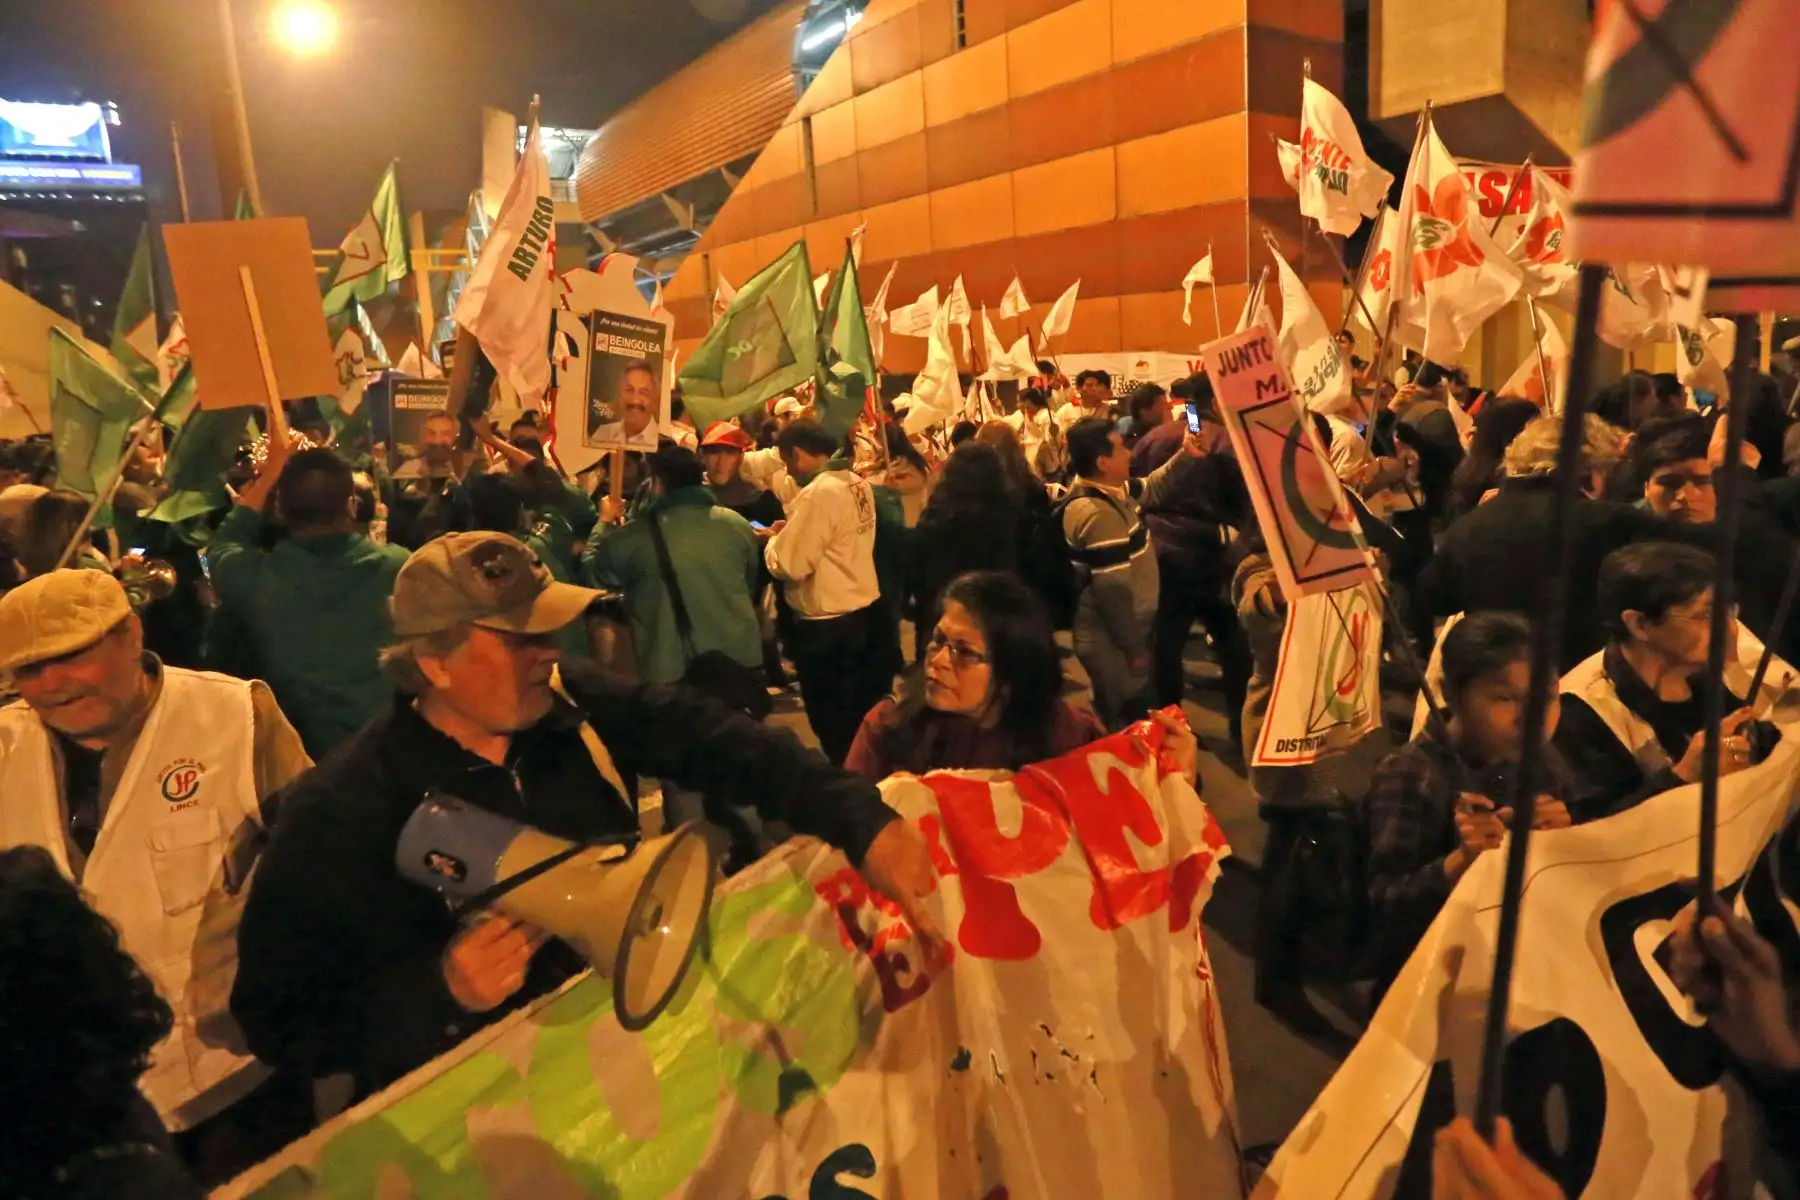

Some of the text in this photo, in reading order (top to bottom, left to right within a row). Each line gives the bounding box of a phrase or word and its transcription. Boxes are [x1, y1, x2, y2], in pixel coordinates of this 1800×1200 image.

[507, 196, 554, 282] ARTURO
[609, 334, 661, 353] BEINGOLEA
[170, 799, 200, 812] LINCE
